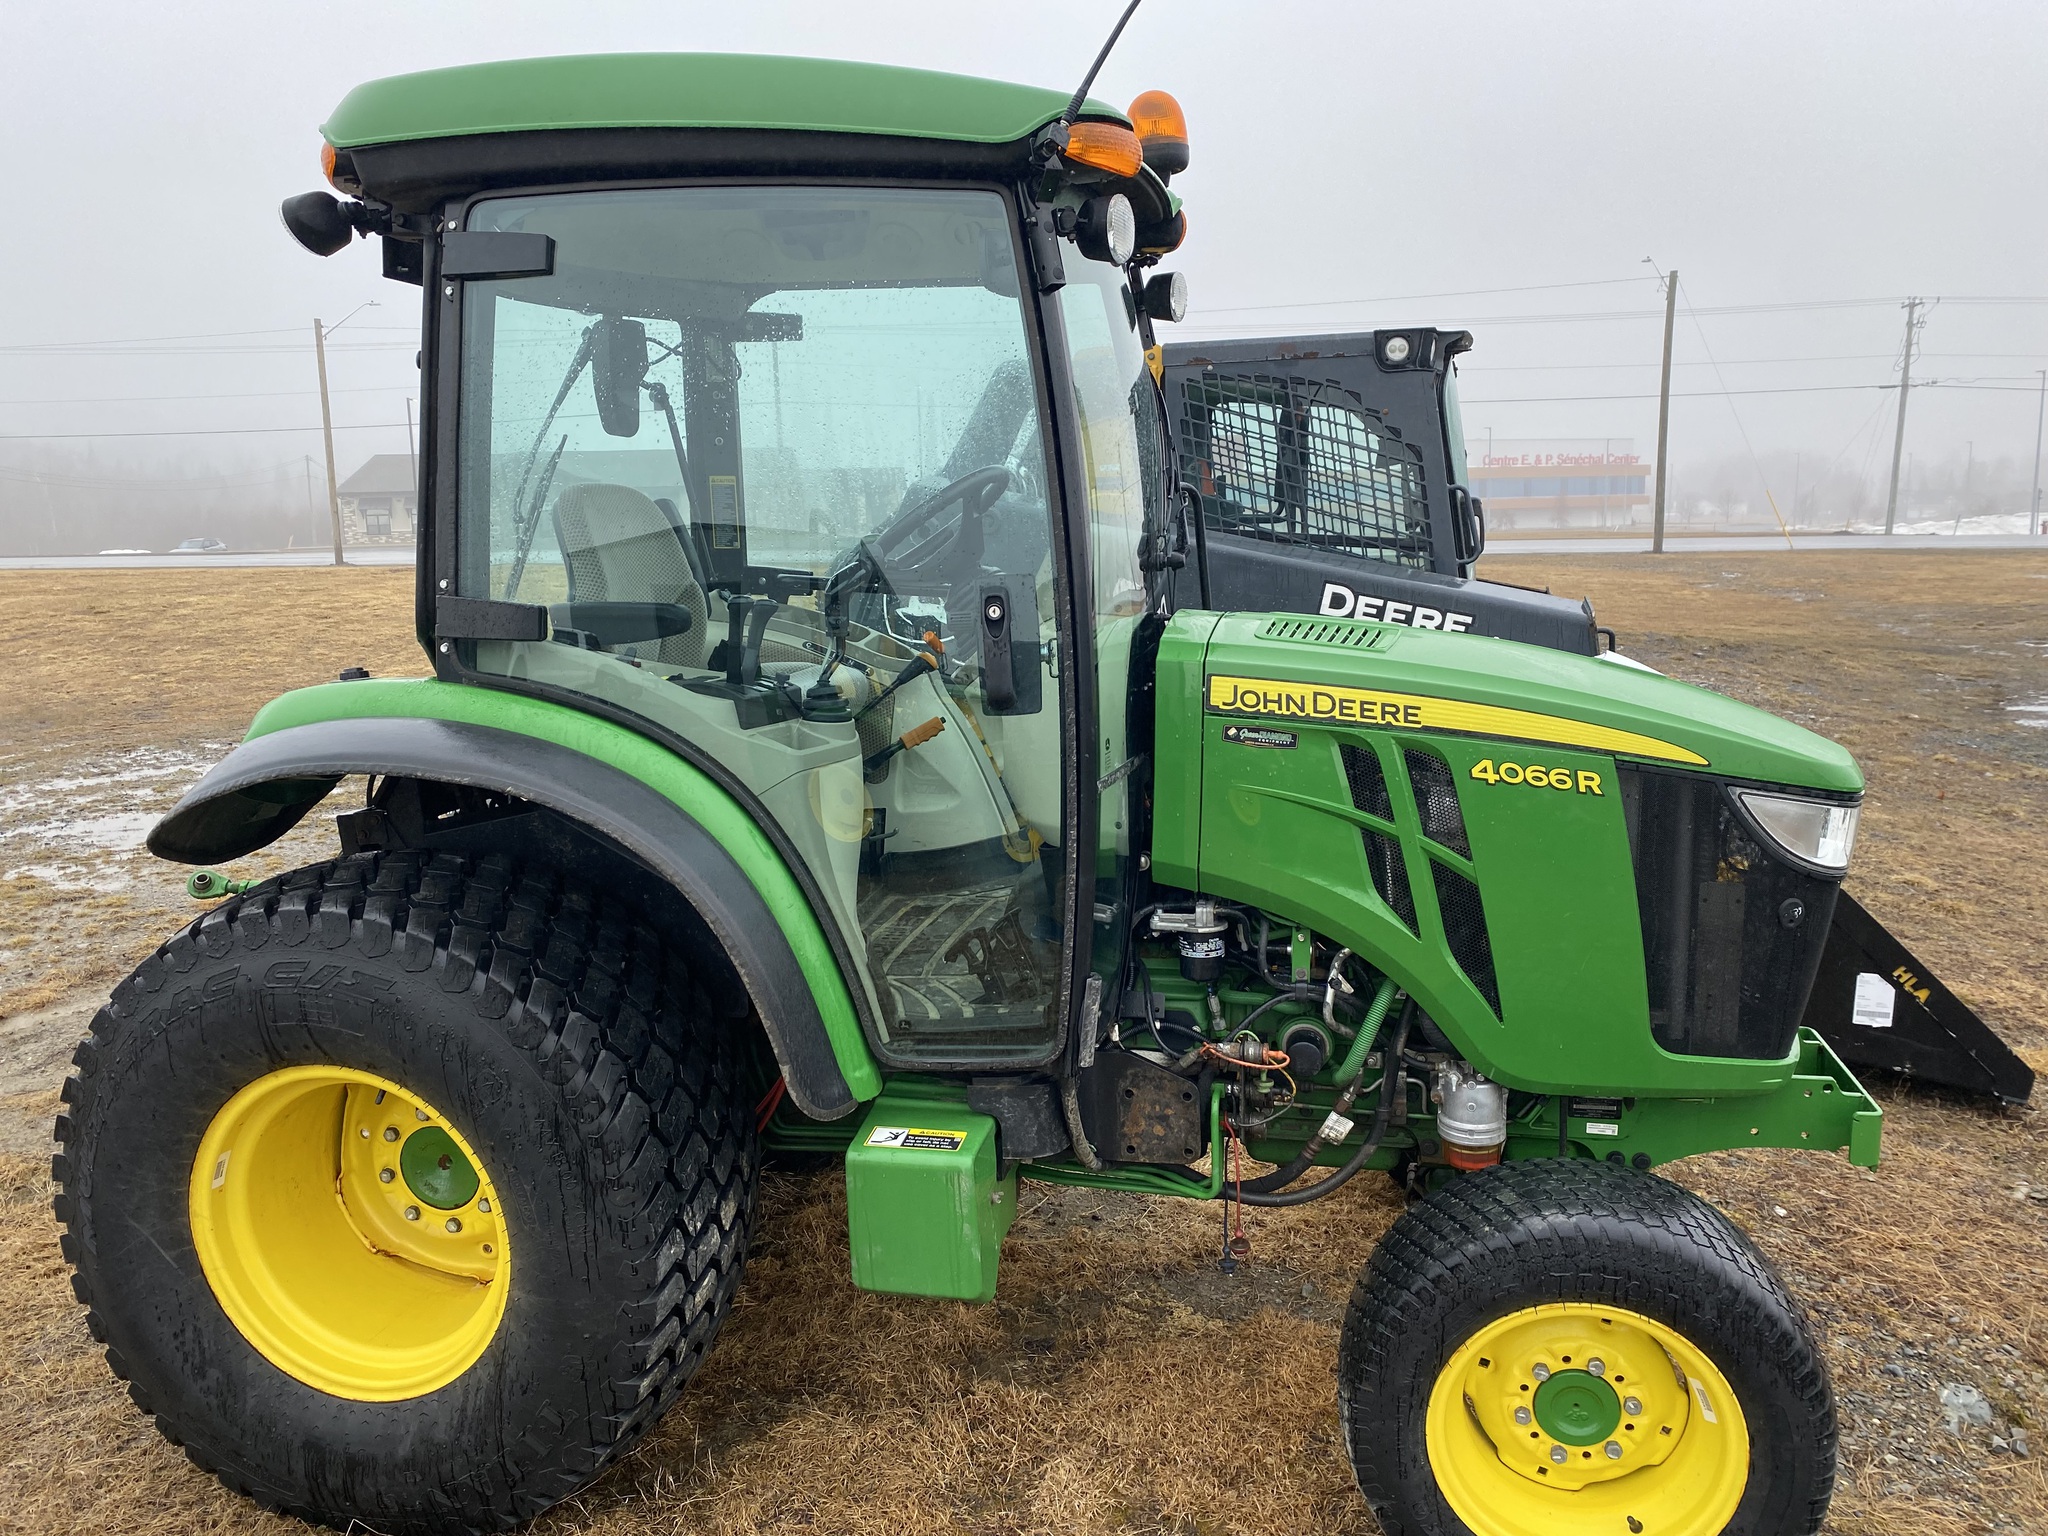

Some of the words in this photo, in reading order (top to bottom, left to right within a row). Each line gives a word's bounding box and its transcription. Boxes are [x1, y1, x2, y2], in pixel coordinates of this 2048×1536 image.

[1483, 454, 1519, 466] Centre
[1521, 455, 1532, 466] E.
[1534, 454, 1542, 465] &
[1545, 454, 1555, 465] P.
[1557, 452, 1604, 465] Sénéchal
[1607, 453, 1641, 465] Center
[1222, 684, 1306, 714] JOHN
[1312, 691, 1422, 725] DEERE
[1892, 965, 1932, 1004] HLA
